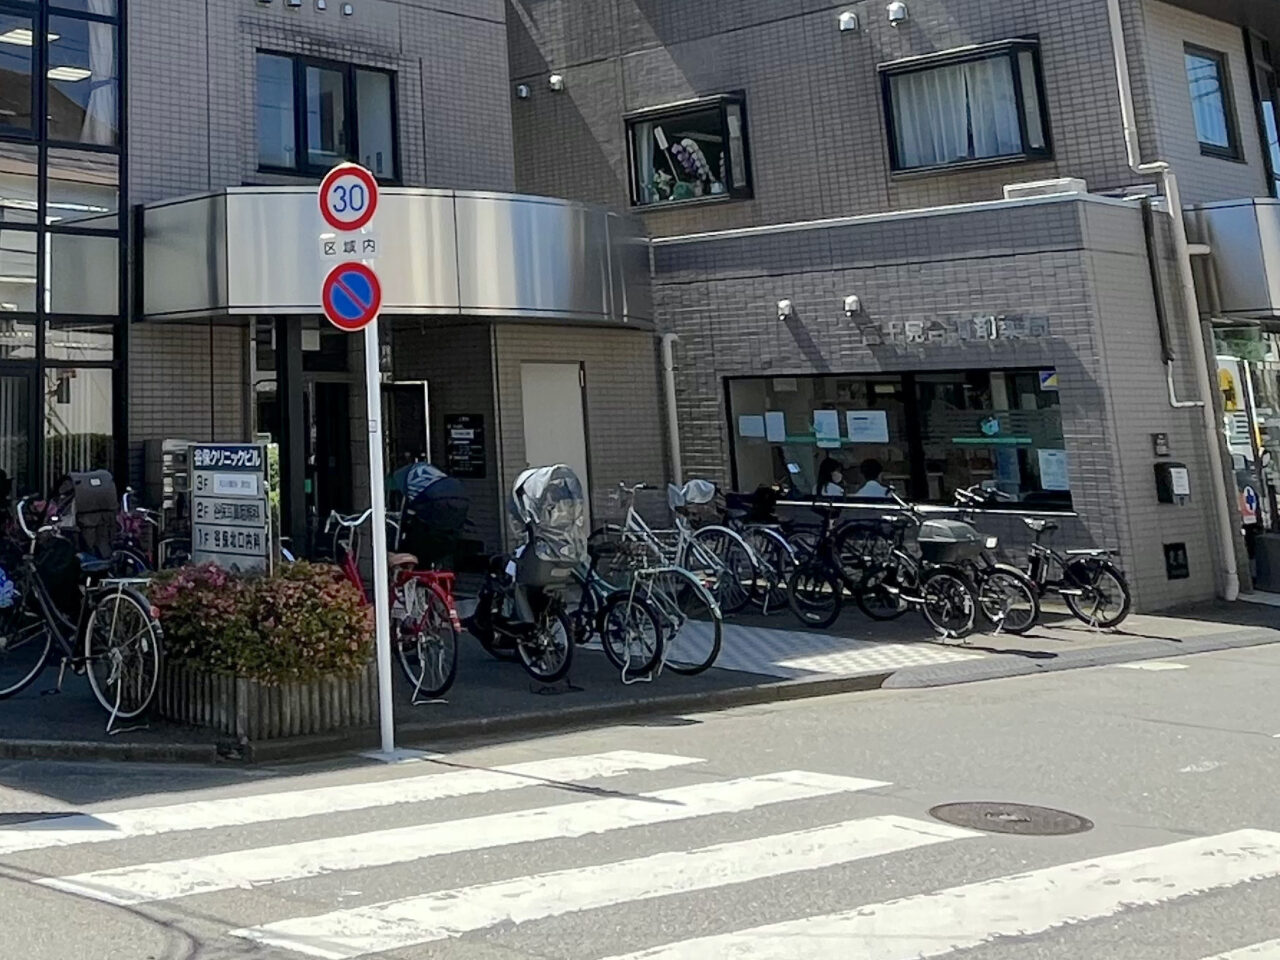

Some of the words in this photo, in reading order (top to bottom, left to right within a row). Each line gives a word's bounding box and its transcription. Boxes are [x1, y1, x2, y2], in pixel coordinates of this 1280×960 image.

[333, 184, 365, 213] 30
[324, 239, 376, 256] 区域内
[196, 474, 209, 491] 3F
[196, 502, 209, 519] 2F
